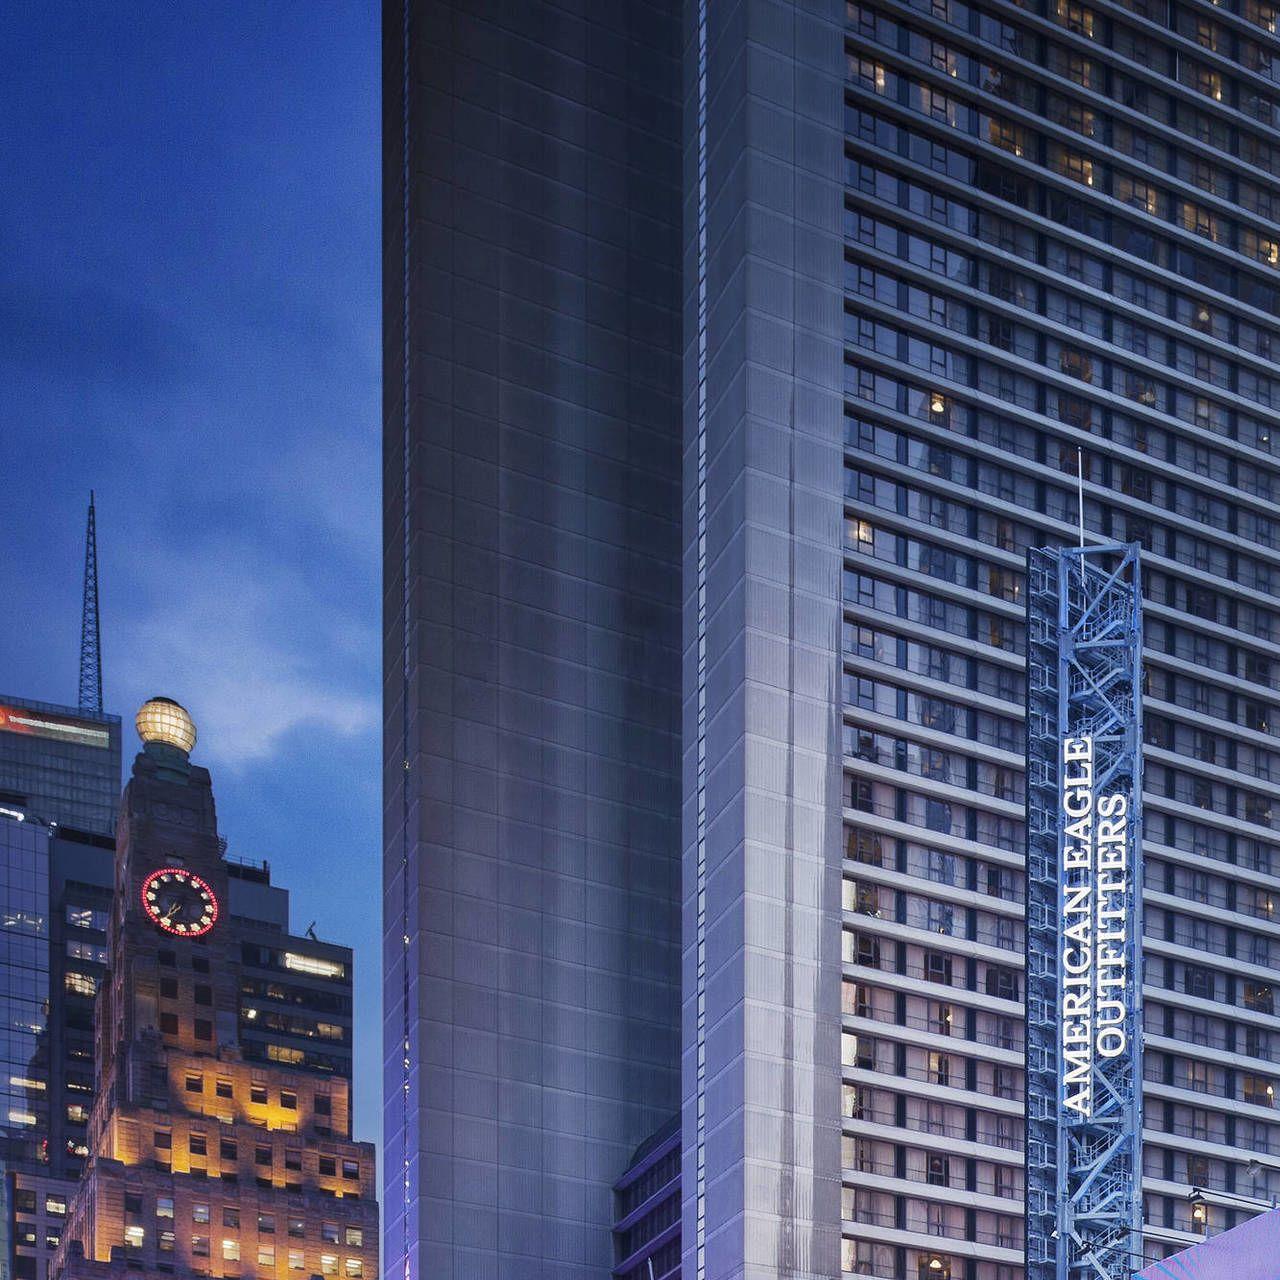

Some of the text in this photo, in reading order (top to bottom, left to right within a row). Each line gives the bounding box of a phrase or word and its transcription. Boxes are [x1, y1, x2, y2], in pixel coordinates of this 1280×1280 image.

[1062, 734, 1093, 1118] AMERICAN EAGLE
[1096, 792, 1128, 1058] OUTFITTERS
